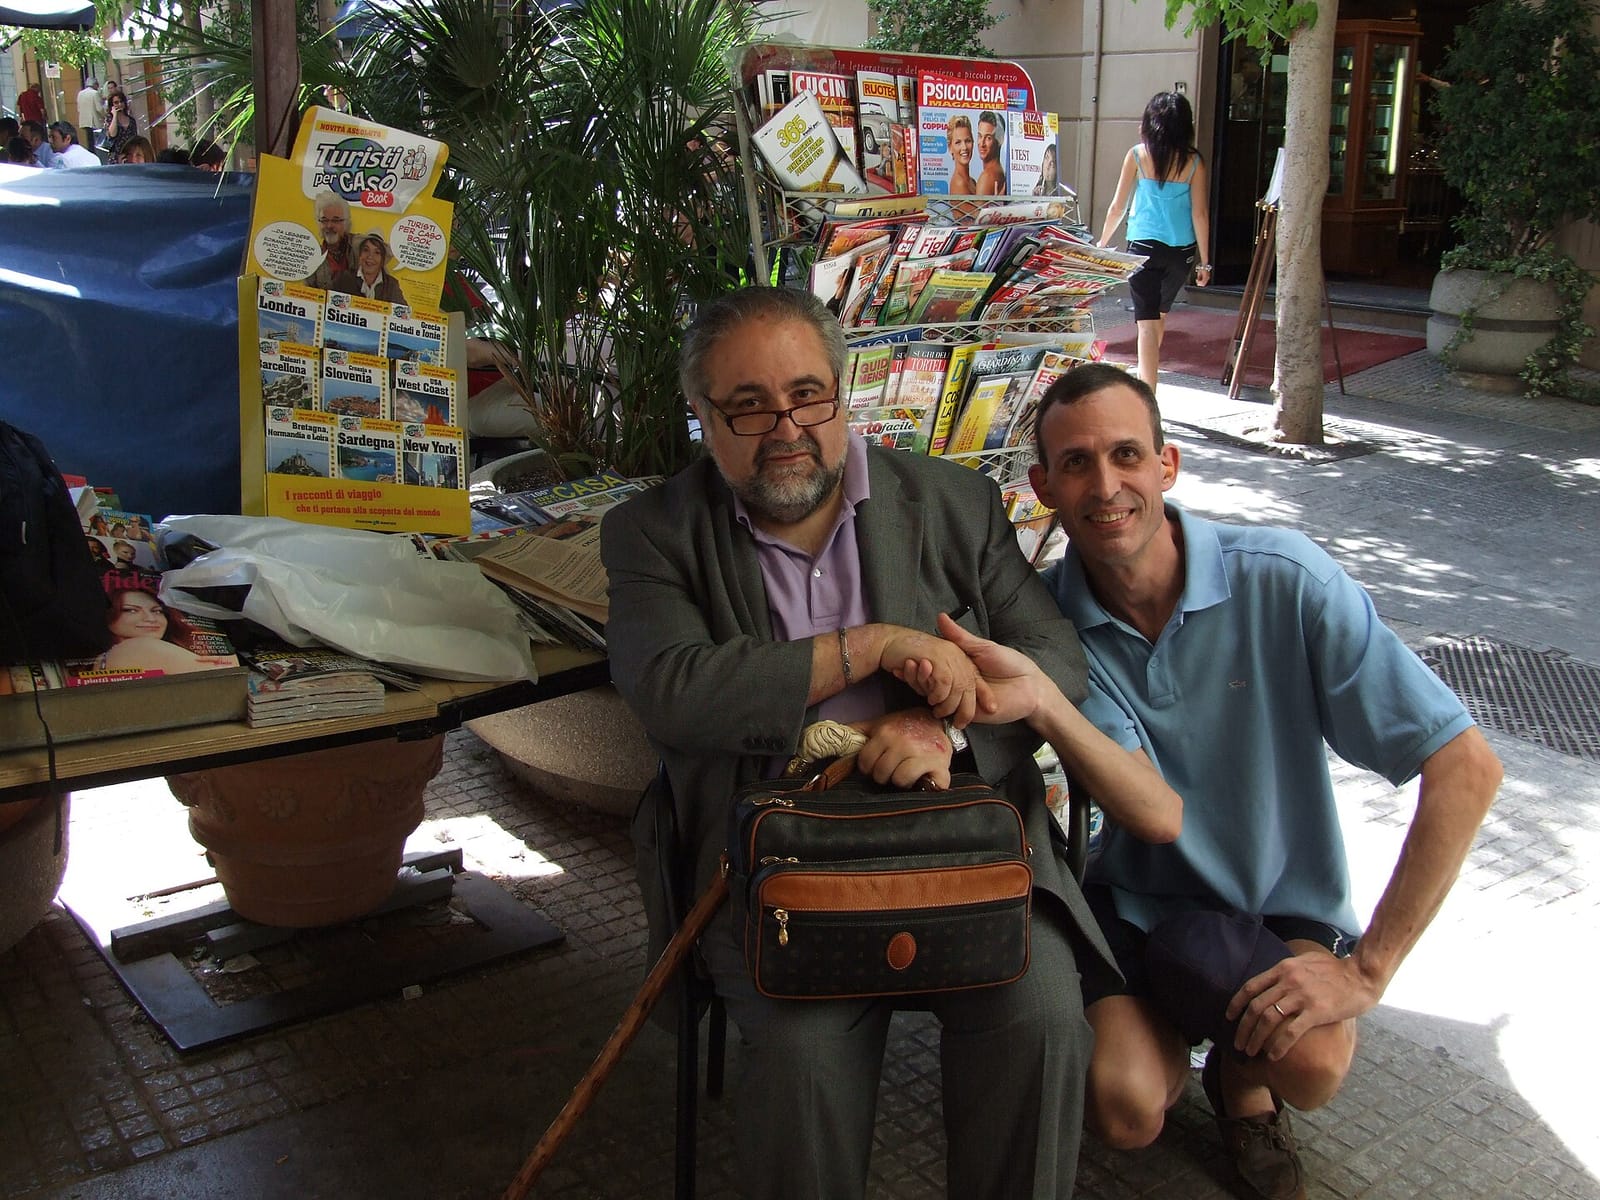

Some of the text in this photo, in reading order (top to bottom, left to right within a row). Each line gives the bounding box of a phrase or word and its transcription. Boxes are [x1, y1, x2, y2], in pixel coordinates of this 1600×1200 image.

[964, 69, 992, 80] piccolo
[994, 73, 1018, 82] prezzo
[923, 82, 1005, 105] PSICOLOGIA
[928, 100, 1005, 110] MAGAZINE
[1024, 112, 1042, 123] RIZA
[777, 114, 807, 148] 365
[922, 122, 950, 131] COPPIA
[316, 143, 404, 169] Turisti
[1015, 148, 1030, 161] TEST
[313, 170, 398, 193] per CASO
[366, 191, 389, 204] Book
[399, 225, 442, 240] PER CASO
[407, 219, 436, 232] TURISTI
[407, 235, 432, 246] BOOK
[259, 296, 306, 317] Londra
[327, 308, 367, 327] Sicilia
[389, 322, 414, 335] Cicladi
[422, 329, 441, 340] Ionie
[421, 322, 440, 331] Grecia
[325, 366, 372, 384] Slovenia
[429, 378, 442, 386] USA
[397, 378, 449, 396] West Coast
[267, 428, 305, 439] Normandia
[312, 433, 329, 442] Loira
[292, 422, 329, 434] Bretagna,
[337, 432, 395, 450] Sardegna
[403, 439, 457, 455] New York
[553, 474, 627, 499] CASA
[293, 489, 332, 500] racconti
[335, 489, 344, 499] di
[347, 489, 382, 501] viaggio
[296, 504, 441, 517] che ti portano alla scoperta del mondo
